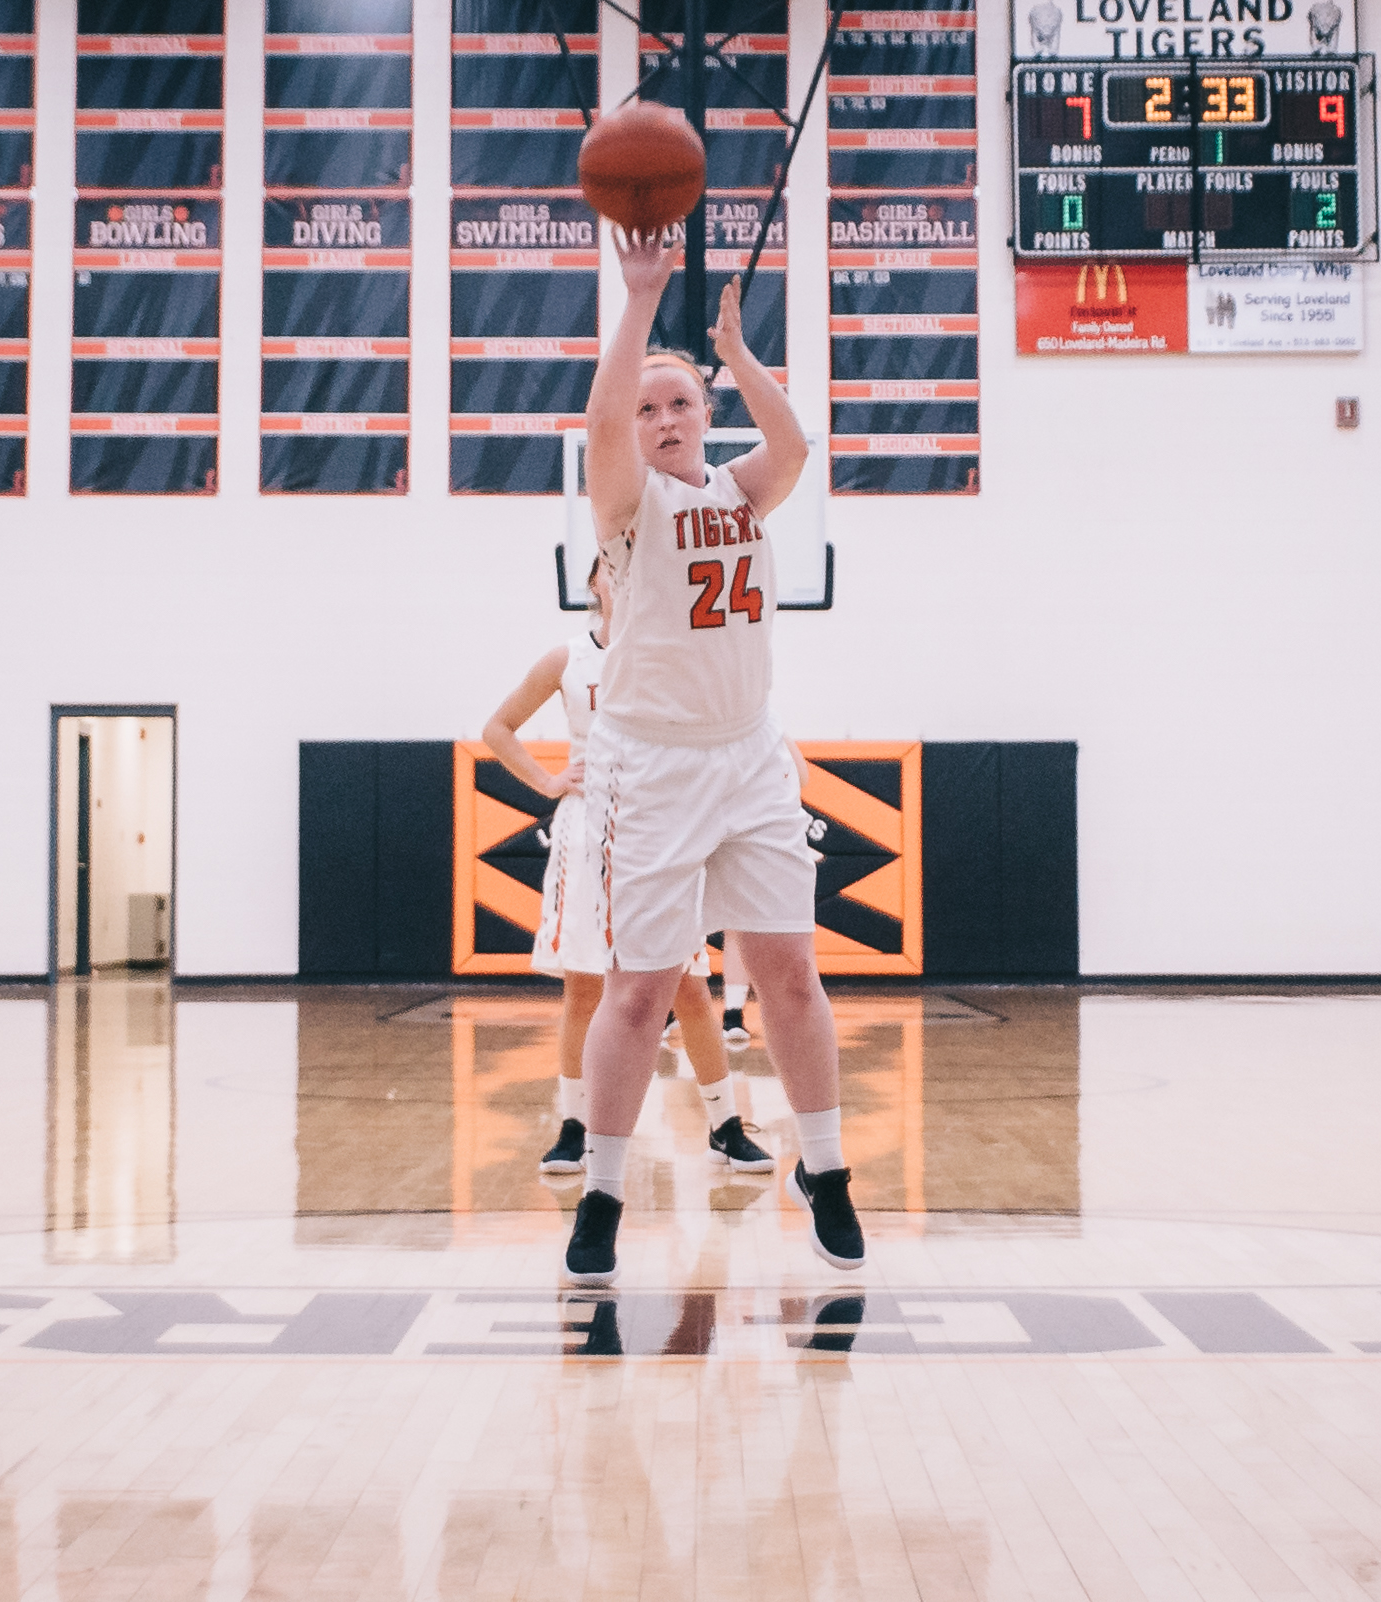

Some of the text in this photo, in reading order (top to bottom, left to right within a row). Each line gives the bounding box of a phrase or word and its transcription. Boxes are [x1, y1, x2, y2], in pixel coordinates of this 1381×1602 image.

[1077, 0, 1292, 22] LOVELAND
[1106, 28, 1265, 57] TIGERS
[870, 78, 937, 94] DISTRICT
[1024, 72, 1094, 94] HOME
[1275, 71, 1350, 92] VISITOR
[1066, 97, 1091, 139] 7
[1319, 95, 1344, 138] 9
[867, 131, 939, 148] REGIONAL
[1216, 131, 1223, 164] 1
[1050, 145, 1103, 163] BONUS
[1150, 147, 1191, 162] PERIO
[1272, 143, 1324, 162] BONUS
[1037, 173, 1086, 193] FOULS
[1205, 173, 1253, 191] FOULS
[1290, 172, 1339, 190] FOULS
[123, 205, 174, 221] GIRLS
[312, 204, 362, 220] GIRLS
[499, 204, 550, 220] GIRLS
[878, 204, 928, 220] GIRLS
[1063, 195, 1083, 230] 0
[1316, 193, 1336, 228] 2
[90, 221, 206, 247] BOWLING
[293, 220, 382, 246] DIVING
[456, 220, 592, 246] SWIMMING
[723, 221, 784, 242] TEAM
[831, 220, 975, 243] BASKETBALL
[1034, 232, 1090, 249] POINTS
[1288, 230, 1344, 248] POINTS
[875, 252, 931, 267] LEAGUE
[1199, 263, 1264, 277] Loveland
[1313, 262, 1353, 281] Whip
[1245, 292, 1350, 308] Serving Loveland
[863, 316, 944, 332] SECTIONAL
[1261, 309, 1293, 322] Since
[295, 339, 376, 356] SECTIONAL
[484, 339, 565, 356] SECTIONAL
[870, 382, 937, 398] DISTRICT
[302, 415, 367, 432] DISTRICT
[491, 415, 556, 432] DISTRICT
[869, 436, 941, 452] REGIONAL
[688, 555, 763, 629] 24
